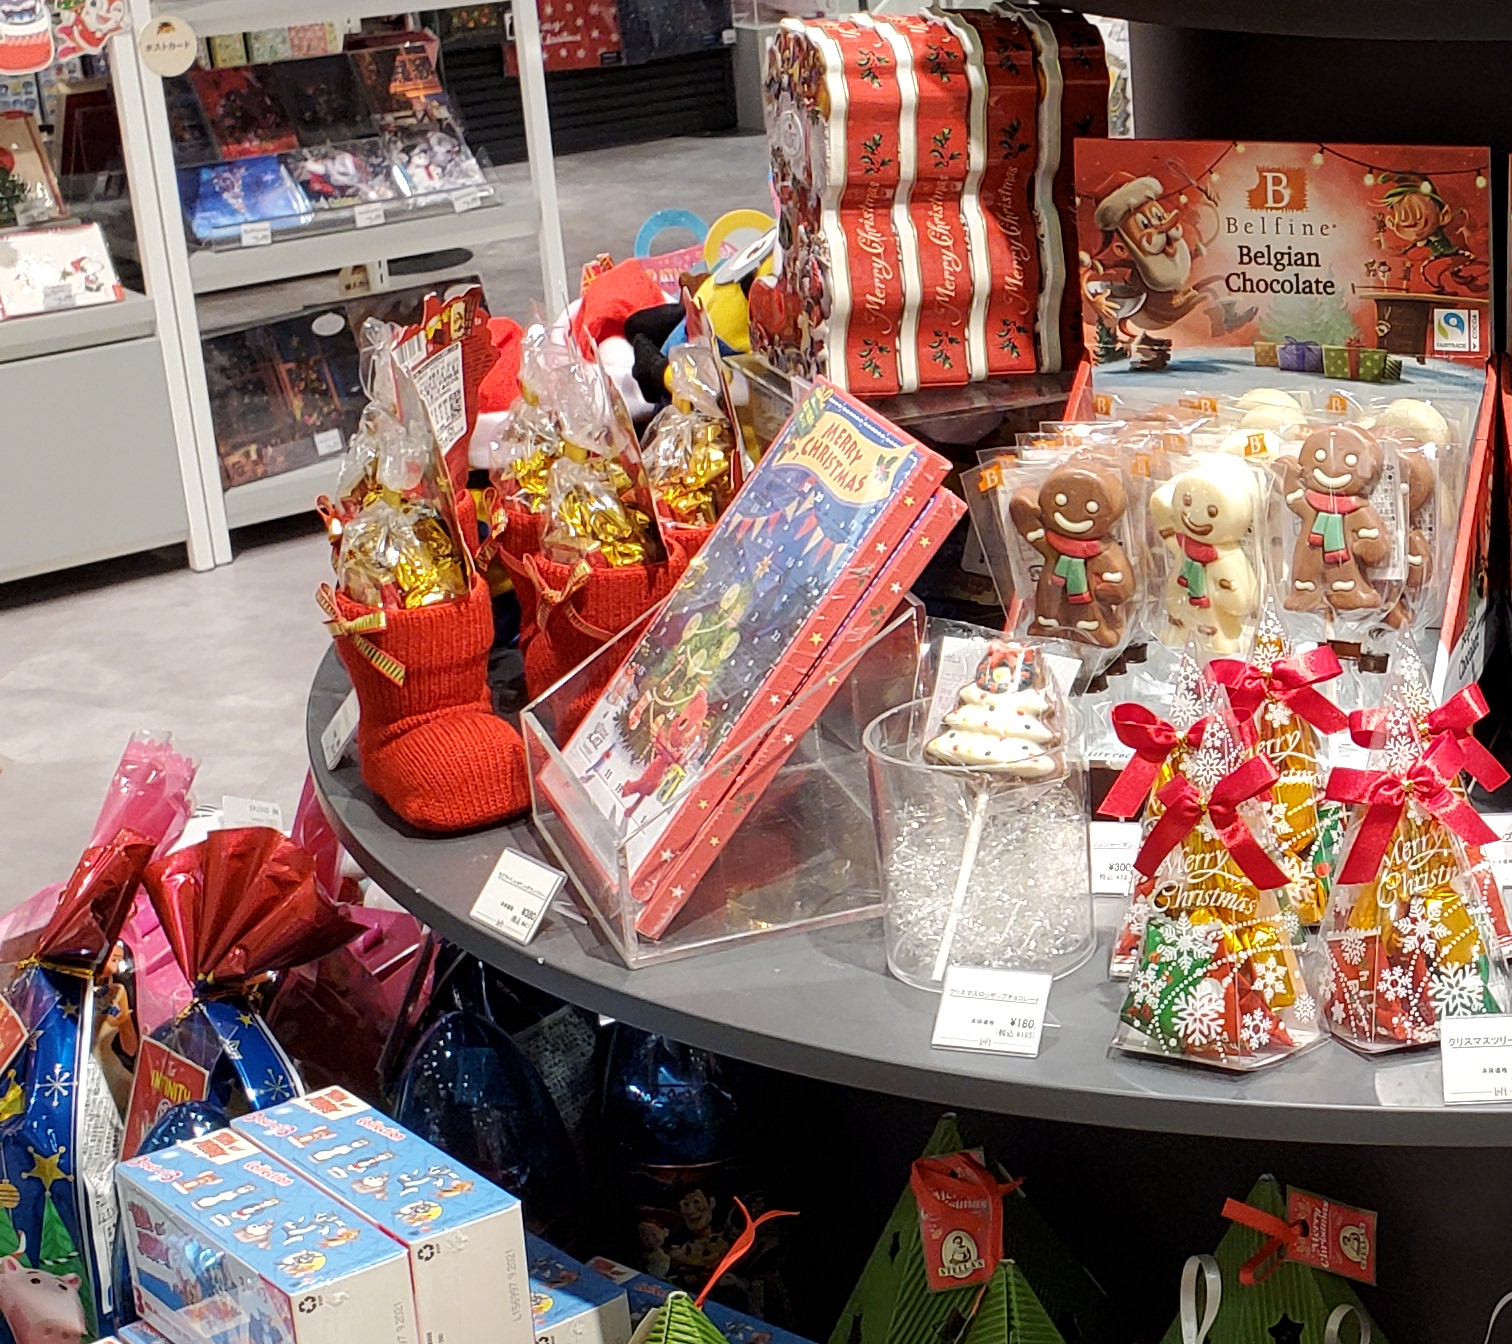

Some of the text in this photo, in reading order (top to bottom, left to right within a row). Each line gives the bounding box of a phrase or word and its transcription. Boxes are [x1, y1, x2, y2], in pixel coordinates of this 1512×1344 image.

[1262, 173, 1291, 207] B
[1226, 216, 1332, 238] Belfine
[1238, 243, 1322, 271] Belgian
[1225, 271, 1336, 297] Chocolate
[820, 421, 864, 467] MERRY
[800, 435, 869, 494] CHRISTMAS
[1160, 844, 1231, 884] Merry
[1379, 827, 1450, 867] Merry
[1147, 881, 1257, 916] Christmas
